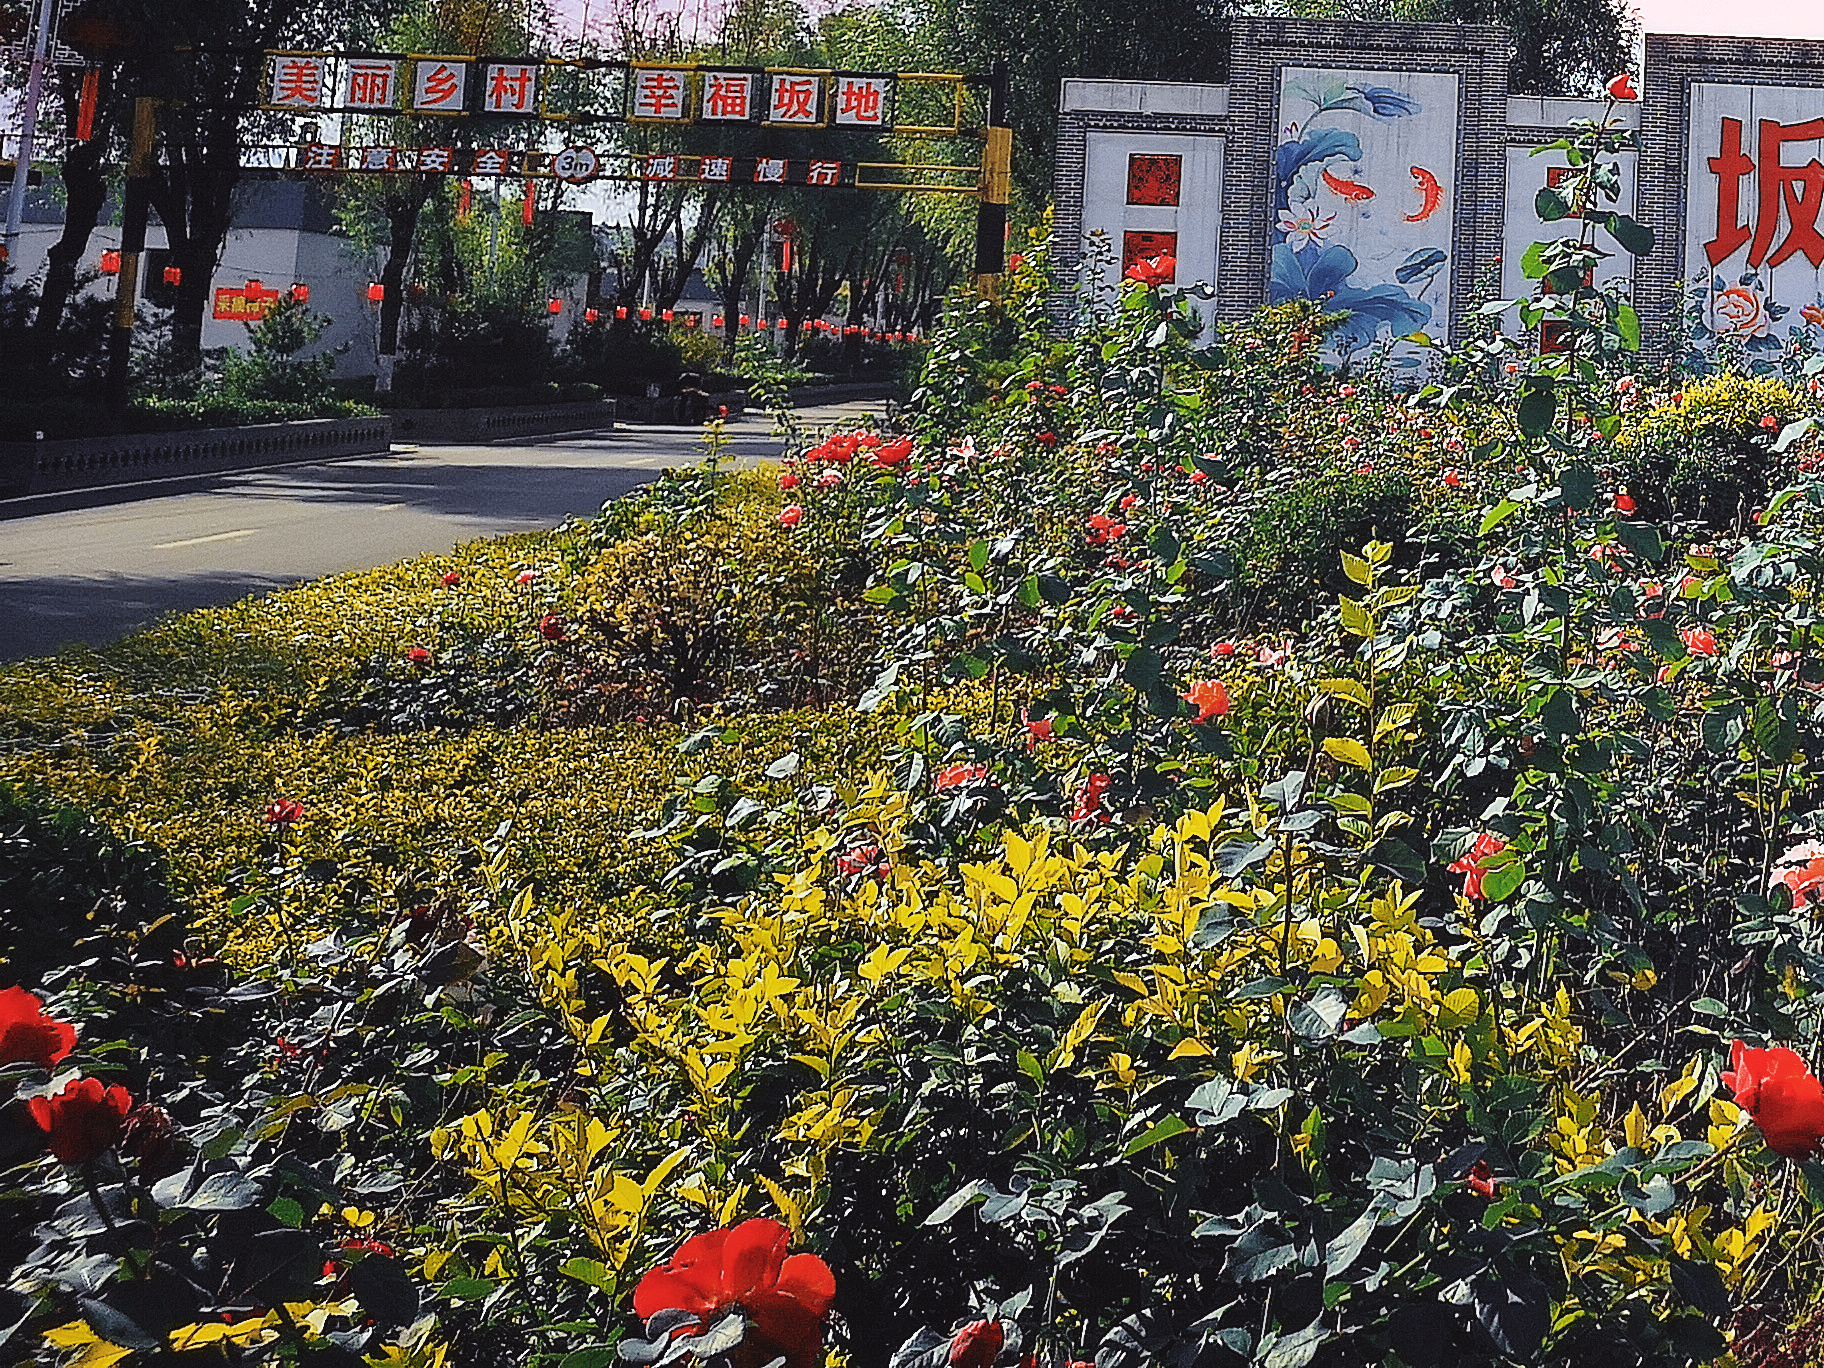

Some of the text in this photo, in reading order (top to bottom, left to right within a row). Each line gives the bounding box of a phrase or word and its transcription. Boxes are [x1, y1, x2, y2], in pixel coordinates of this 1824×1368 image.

[278, 60, 880, 121] 美丽乡村 幸福坂地
[305, 146, 509, 174] 注意安全
[647, 156, 838, 185] 减速慢行
